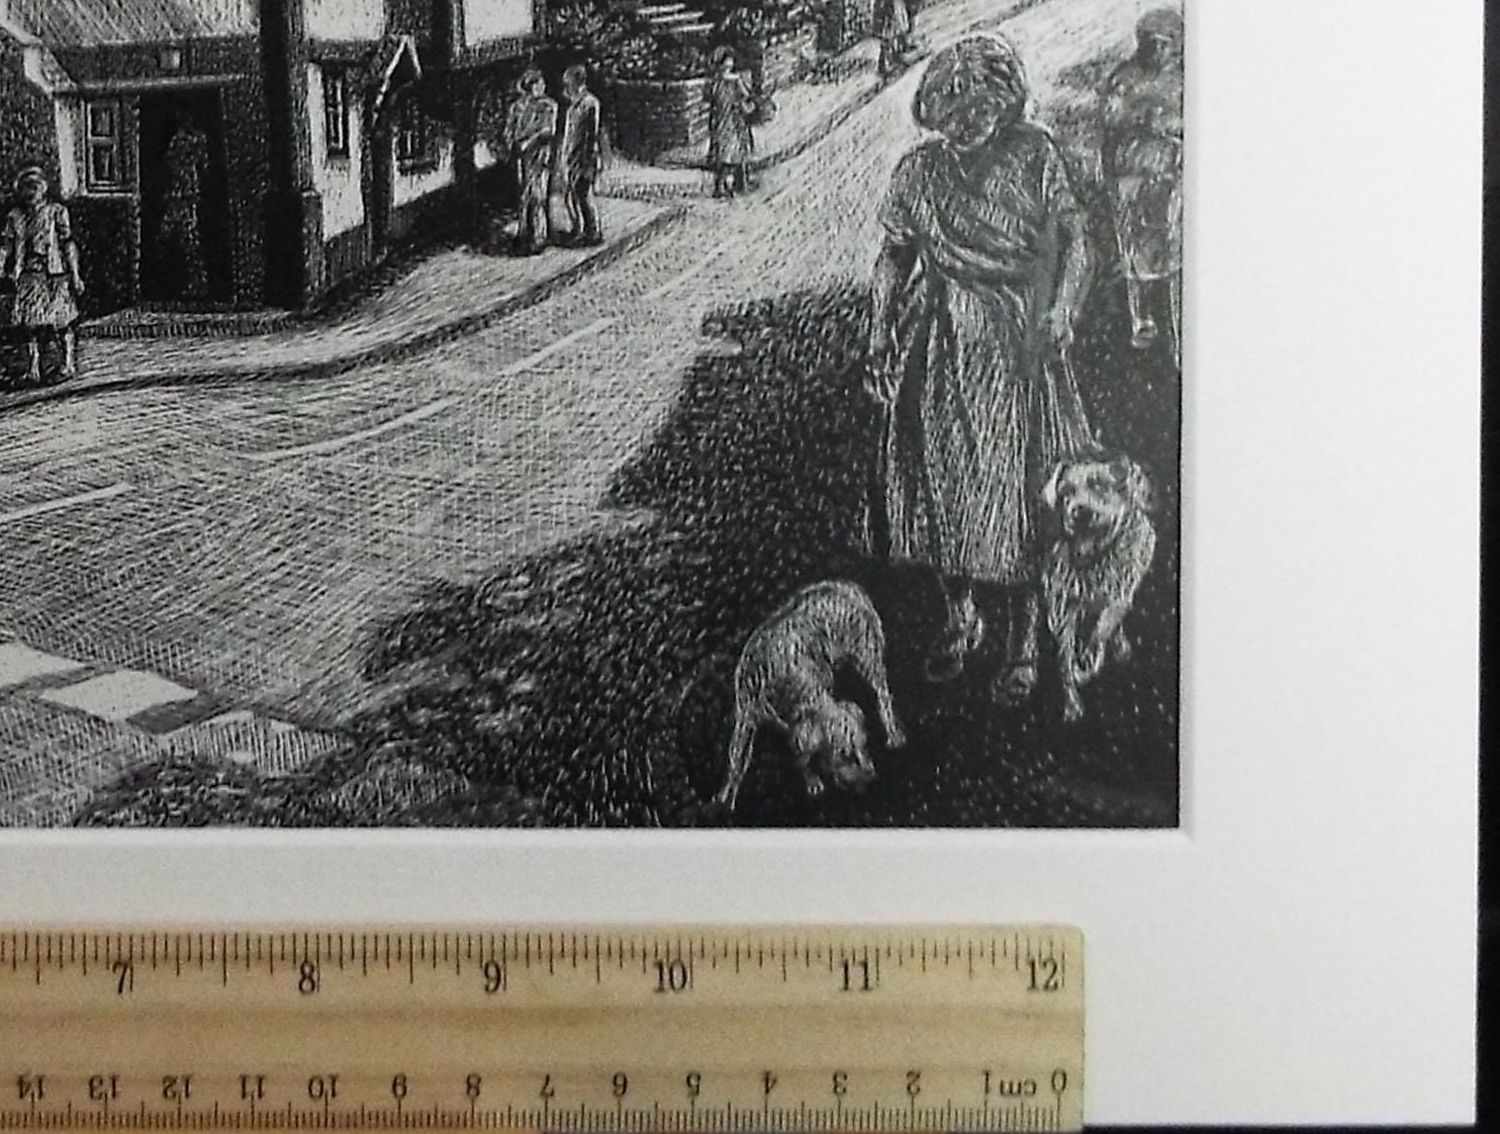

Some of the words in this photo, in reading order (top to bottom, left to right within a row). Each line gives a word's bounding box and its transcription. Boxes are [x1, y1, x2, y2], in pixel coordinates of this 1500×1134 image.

[114, 962, 129, 994] 7
[299, 962, 316, 994] 8
[483, 962, 500, 994] 9
[653, 960, 687, 993] 10
[840, 960, 872, 991] 11
[1027, 959, 1058, 991] 12
[17, 1075, 45, 1100] 14
[89, 1075, 120, 1100] 13
[163, 1075, 191, 1100] 12
[238, 1075, 265, 1100] 11
[308, 1074, 339, 1098] 10
[393, 1074, 407, 1097] 9
[466, 1073, 481, 1097] 8
[540, 1073, 555, 1097] 7
[613, 1072, 628, 1096] 6
[686, 1072, 700, 1096] 5
[761, 1072, 778, 1095] 4
[833, 1072, 847, 1097] 3
[906, 1072, 921, 1096] 2
[981, 1071, 992, 1095] 1
[1000, 1077, 1036, 1095] cm
[1051, 1072, 1067, 1095] 0
